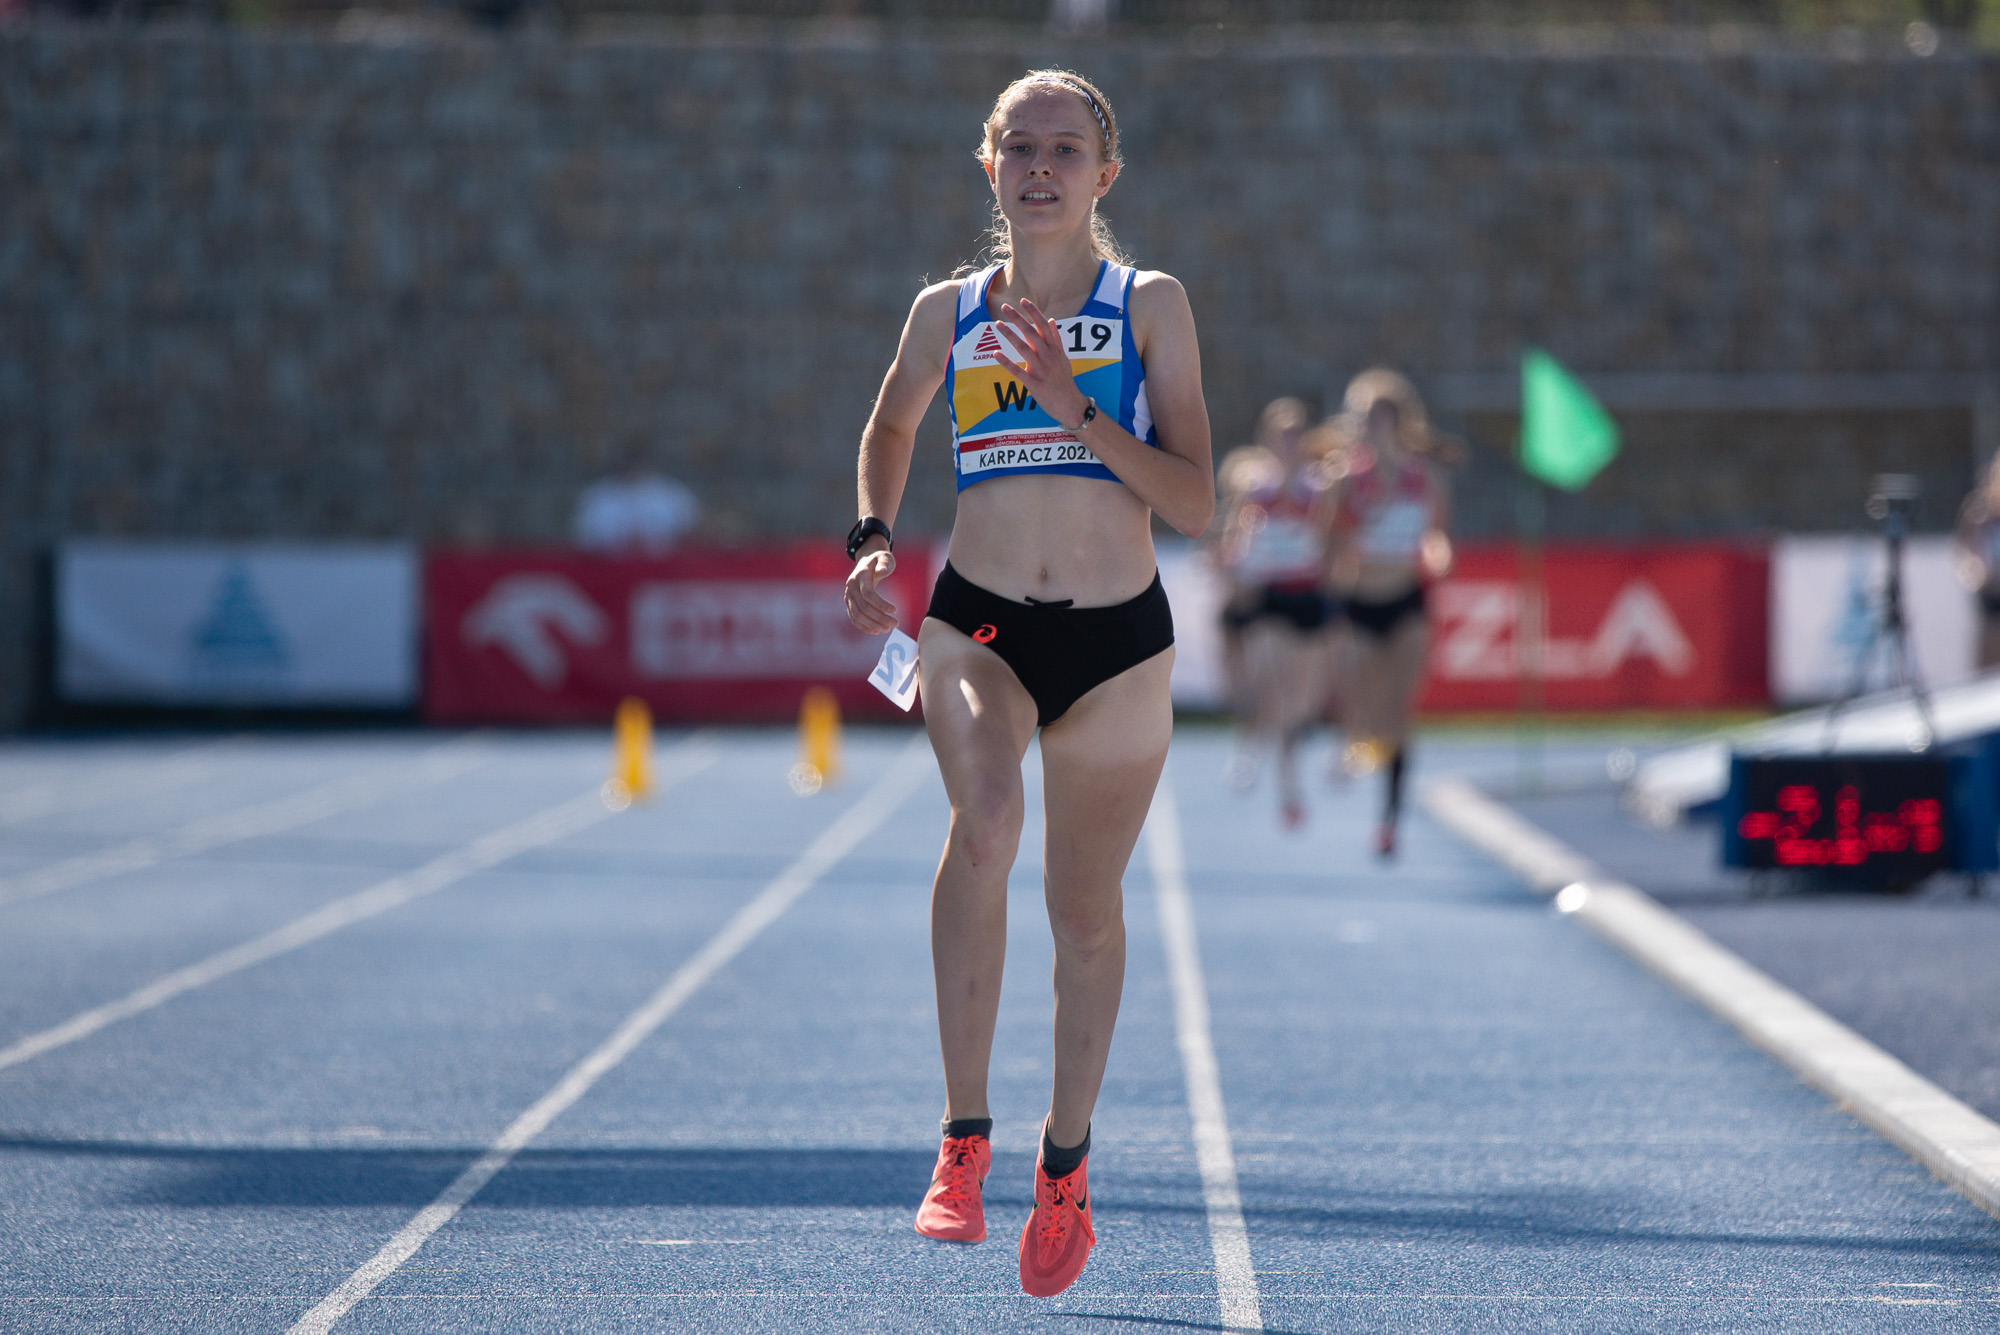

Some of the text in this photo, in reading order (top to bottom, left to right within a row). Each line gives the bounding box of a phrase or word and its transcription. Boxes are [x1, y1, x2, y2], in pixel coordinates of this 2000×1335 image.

[1056, 322, 1112, 352] 19
[973, 353, 995, 361] KARPA
[979, 447, 1052, 468] KARPACZ
[1430, 577, 1699, 681] ZLA
